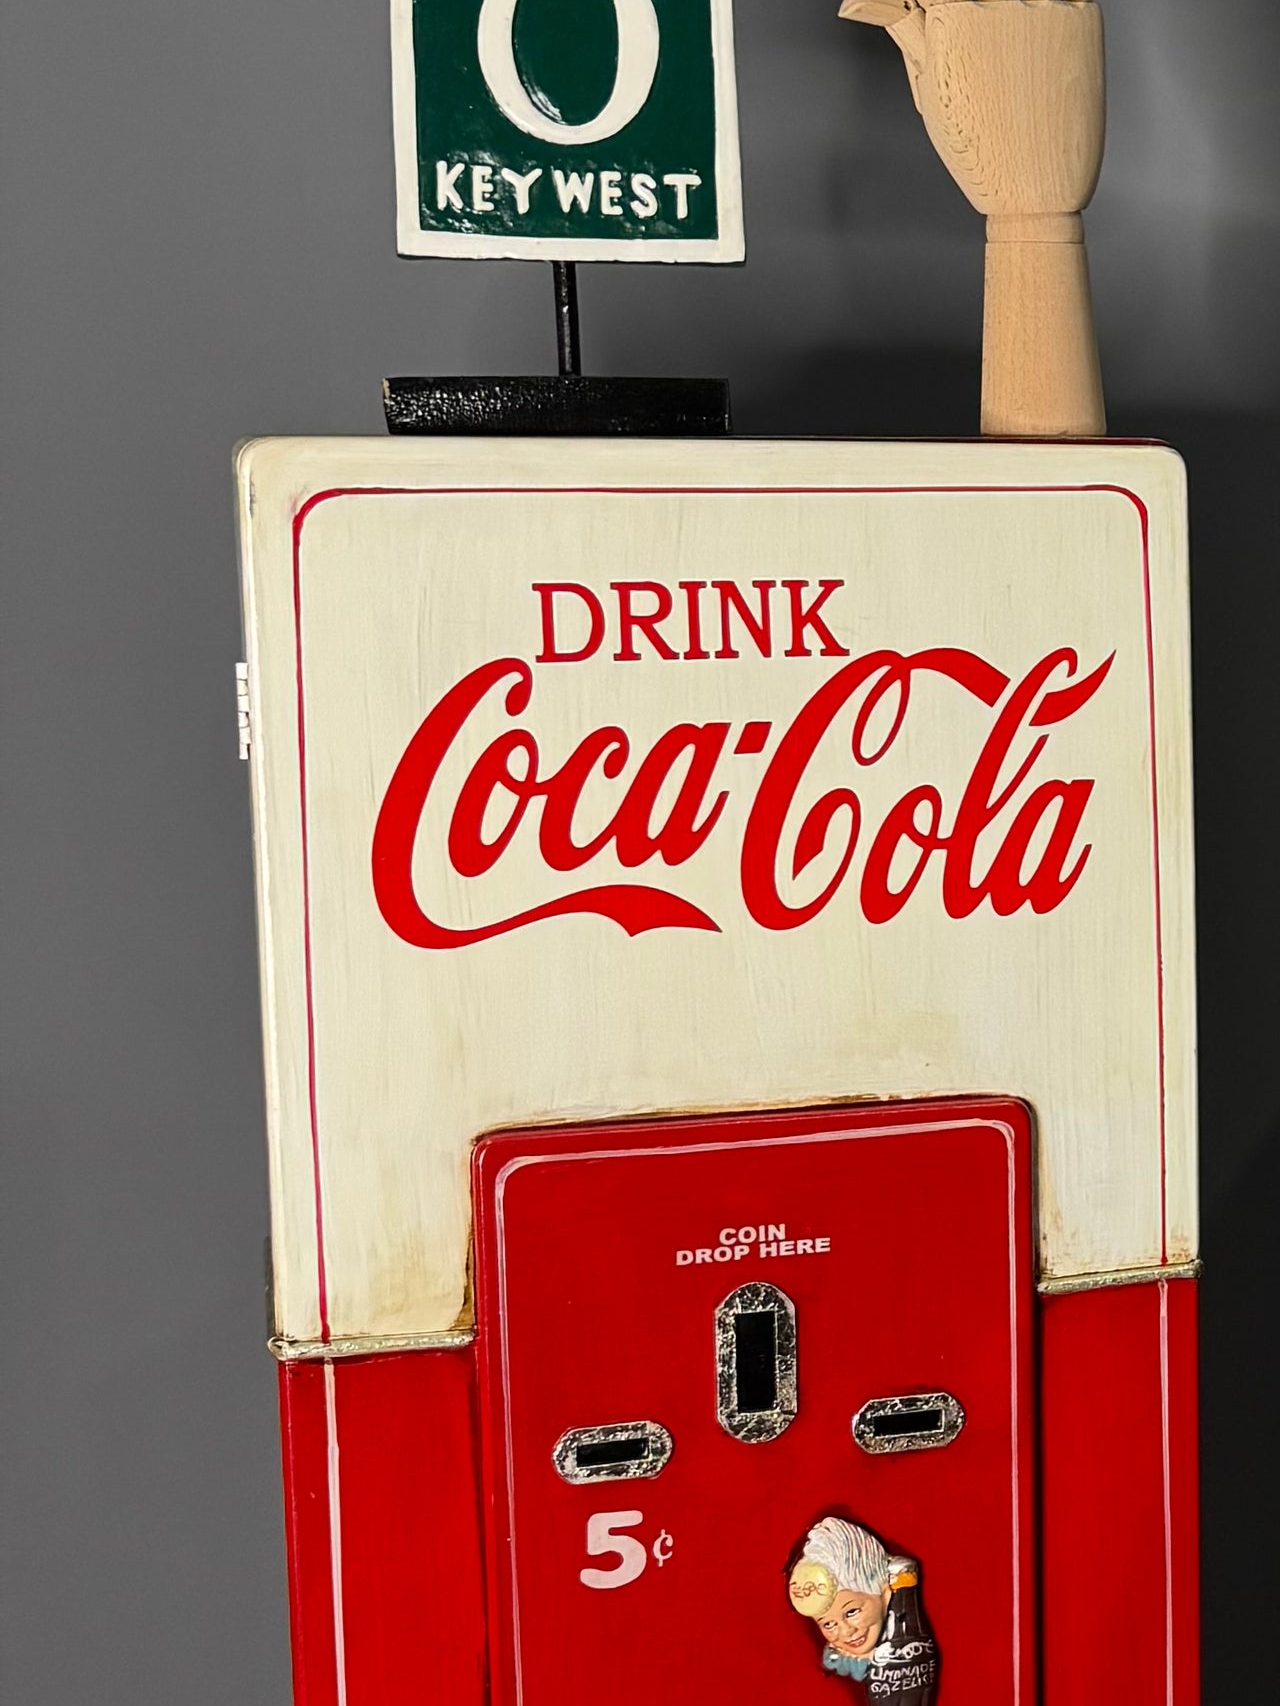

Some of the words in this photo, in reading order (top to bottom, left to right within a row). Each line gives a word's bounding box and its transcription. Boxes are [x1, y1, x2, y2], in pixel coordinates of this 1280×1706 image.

[435, 159, 543, 216] KEY
[550, 165, 703, 220] WEST
[531, 579, 850, 663] DRINK
[370, 646, 1116, 951] Coca-Cola
[676, 1244, 750, 1266] DROP
[759, 1237, 831, 1259] HERE
[719, 1223, 786, 1246] COIN
